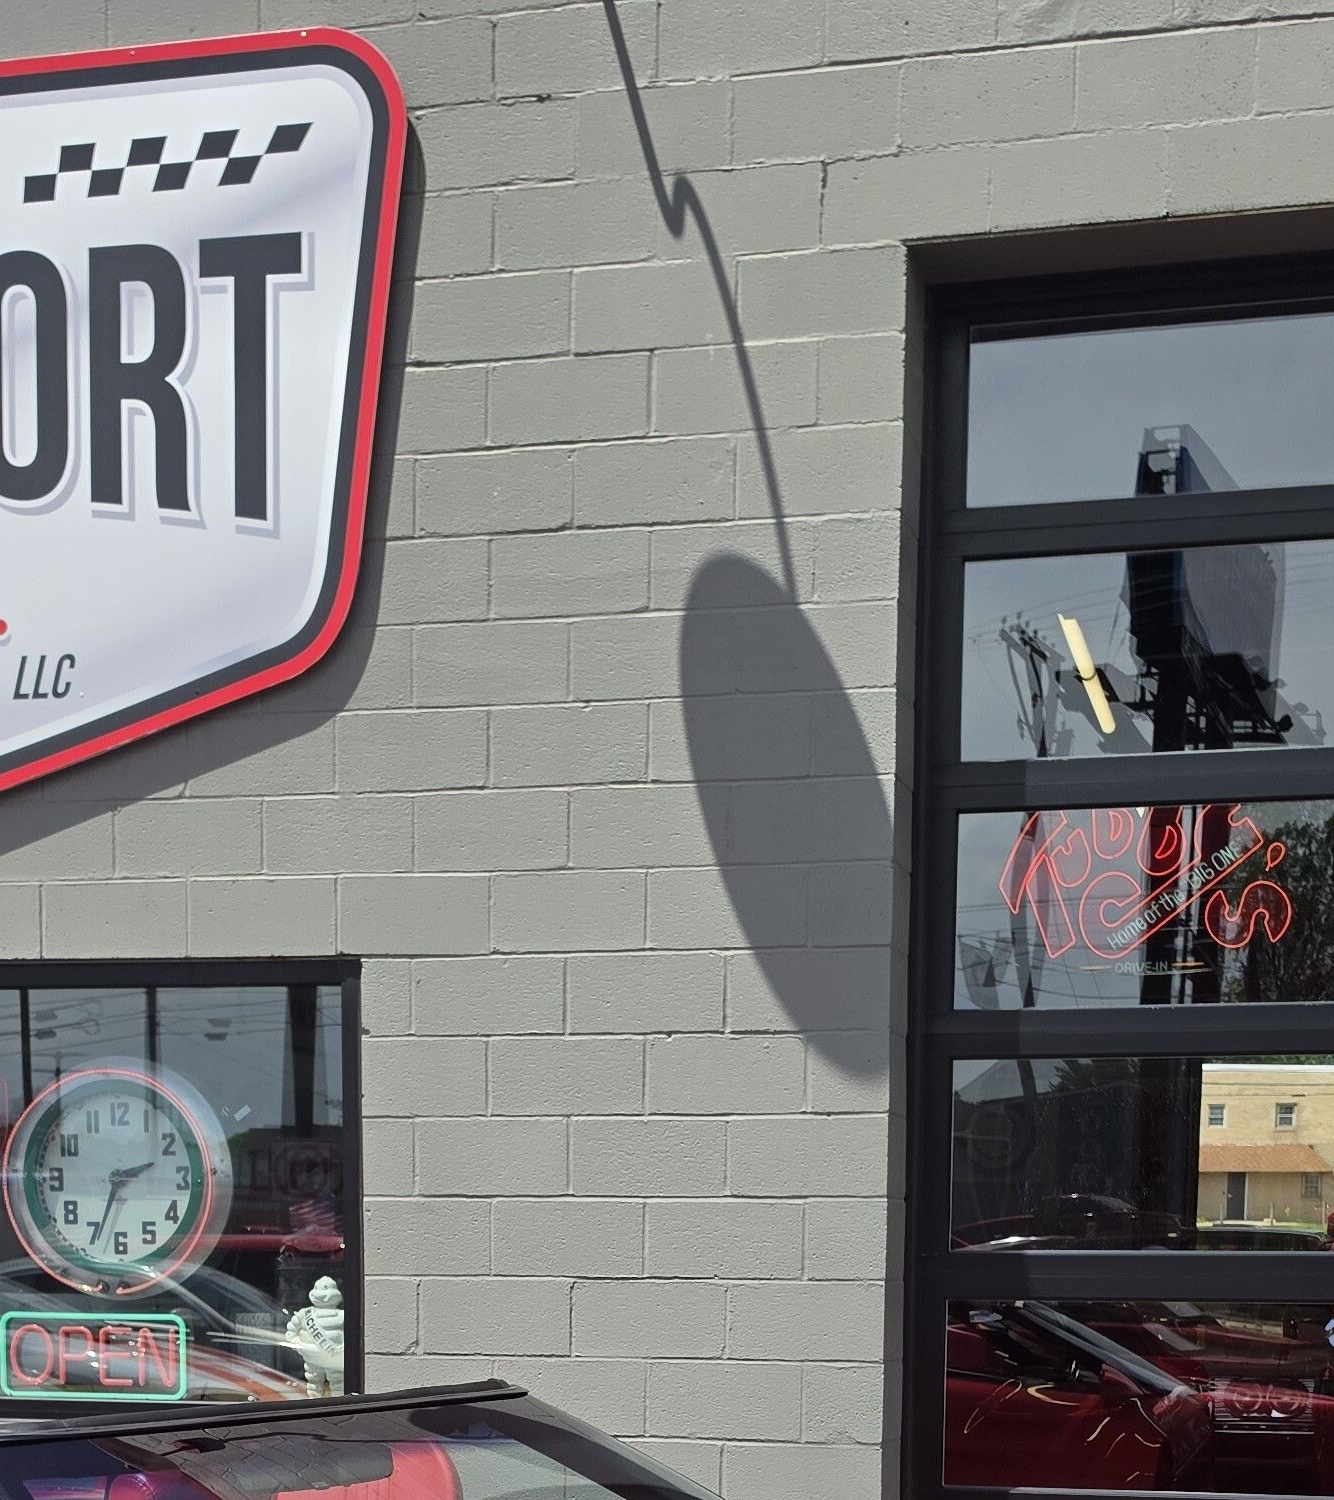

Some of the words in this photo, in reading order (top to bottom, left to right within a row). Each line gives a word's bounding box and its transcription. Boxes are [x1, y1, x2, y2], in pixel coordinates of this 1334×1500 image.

[12, 652, 76, 702] LLC
[1107, 917, 1147, 951] Home
[1144, 901, 1162, 924] of
[1156, 886, 1185, 911] the
[1187, 860, 1215, 890] BIG
[1210, 843, 1241, 872] ONE
[1114, 961, 1168, 974] DRIVE-IN
[86, 1110, 100, 1134] 11
[110, 1102, 130, 1126] 12
[143, 1109, 150, 1133] 1
[60, 1134, 79, 1157] 10
[161, 1133, 176, 1156] 2
[49, 1167, 64, 1192] 9
[175, 1166, 190, 1190] 3
[63, 1200, 79, 1225] 8
[164, 1200, 180, 1224] 4
[86, 1221, 101, 1245] 7
[113, 1231, 128, 1255] 6
[141, 1221, 157, 1245] 5
[9, 1323, 178, 1388] OPEN
